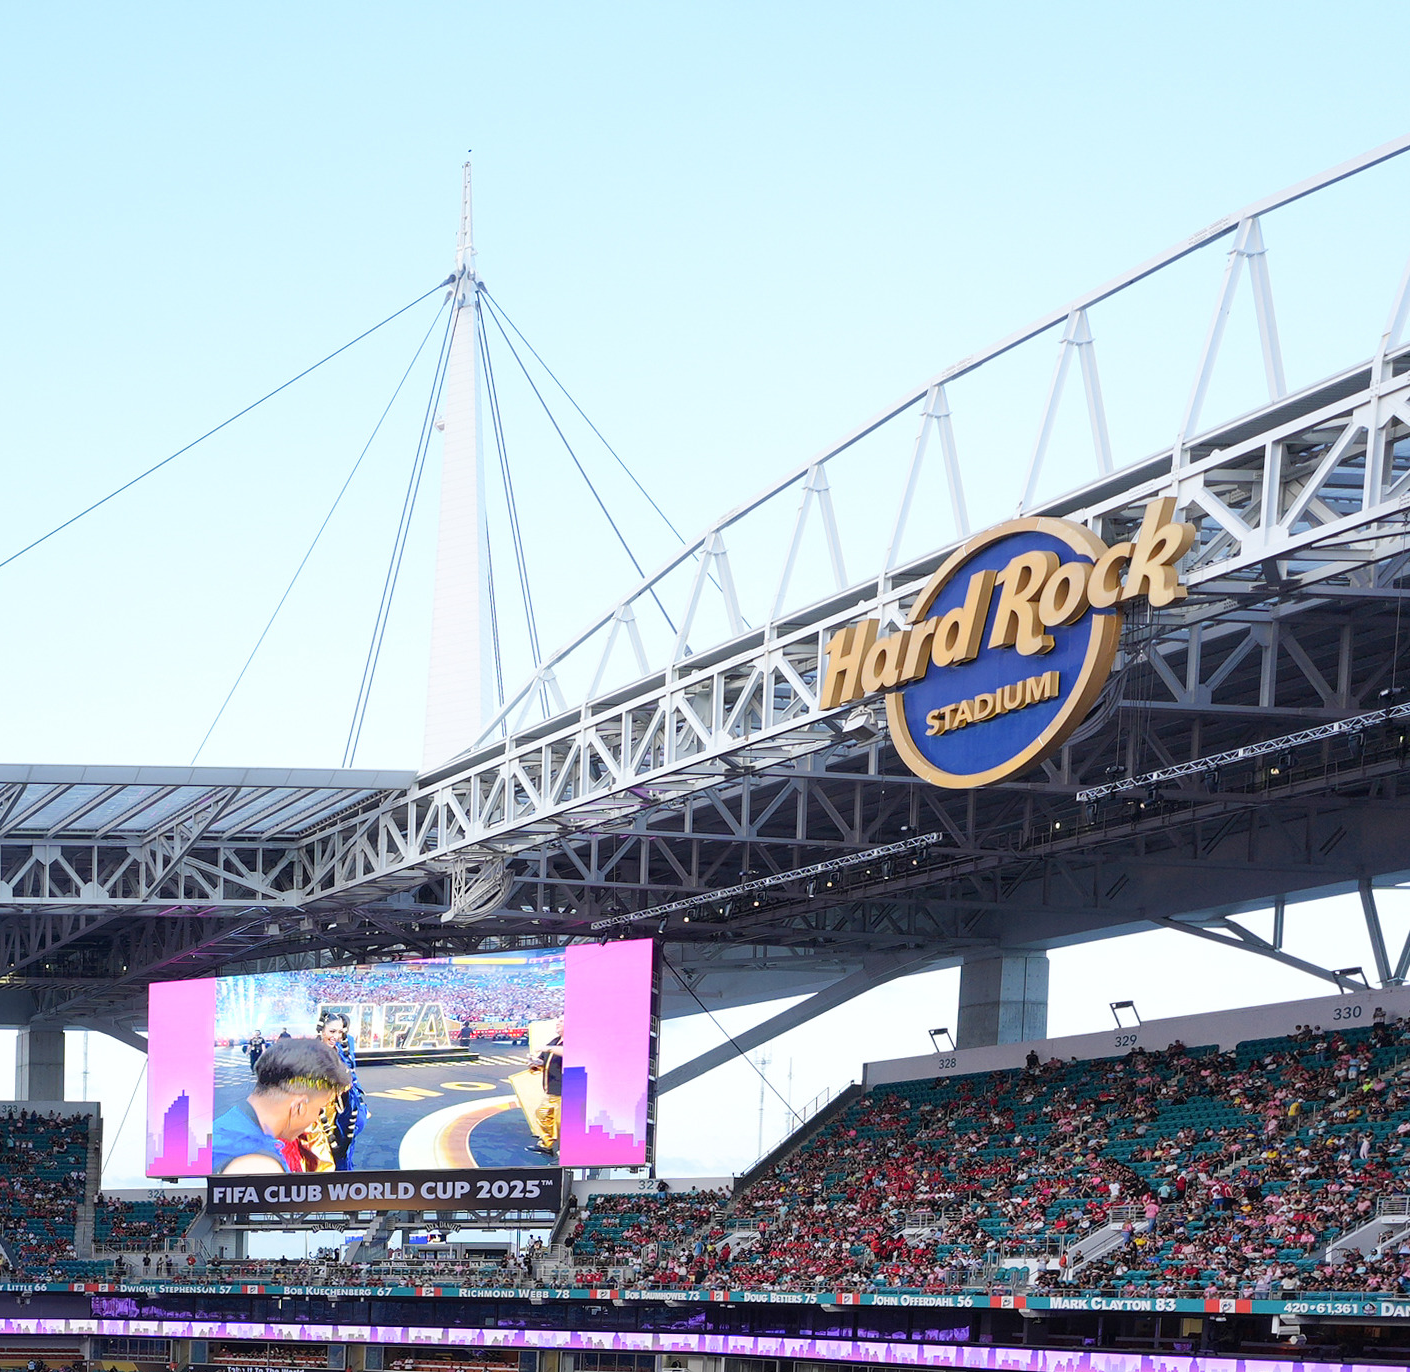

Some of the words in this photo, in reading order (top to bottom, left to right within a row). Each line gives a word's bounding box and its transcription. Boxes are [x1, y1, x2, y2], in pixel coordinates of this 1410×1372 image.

[819, 569, 999, 711] Hard
[989, 497, 1196, 656] Rock
[925, 671, 1060, 738] STADIUM
[1333, 1005, 1362, 1021] 330
[1114, 1035, 1138, 1047] 329
[938, 1058, 957, 1070] 328
[1, 1105, 18, 1114] 323
[213, 1186, 259, 1204] FIFA
[264, 1184, 322, 1203] CLUB
[327, 1181, 416, 1202] WORLD
[420, 1181, 471, 1200] CUP
[7, 1284, 32, 1292] LITTLE
[34, 1284, 47, 1292] 66
[119, 1285, 156, 1294] DWIGHT
[159, 1285, 216, 1295] STEPHENSON
[219, 1286, 232, 1295] 57
[283, 1287, 303, 1296] BOB
[306, 1287, 372, 1297] KUECHENBERG
[376, 1288, 392, 1297] 67
[459, 1288, 514, 1299] RICHMOND
[517, 1289, 549, 1299] WEBB
[555, 1289, 570, 1299] 78
[625, 1290, 639, 1300] BOB
[687, 1291, 700, 1302] 73
[743, 1293, 768, 1303] DOUG
[770, 1294, 803, 1304] BETTERS
[804, 1294, 817, 1304] 75
[871, 1295, 897, 1306] JOHN
[900, 1295, 954, 1307] OFFERDAHL
[957, 1297, 972, 1308] 56
[1049, 1297, 1088, 1310] MARK
[1090, 1298, 1151, 1311] CLAYTON
[1155, 1299, 1176, 1312] 83
